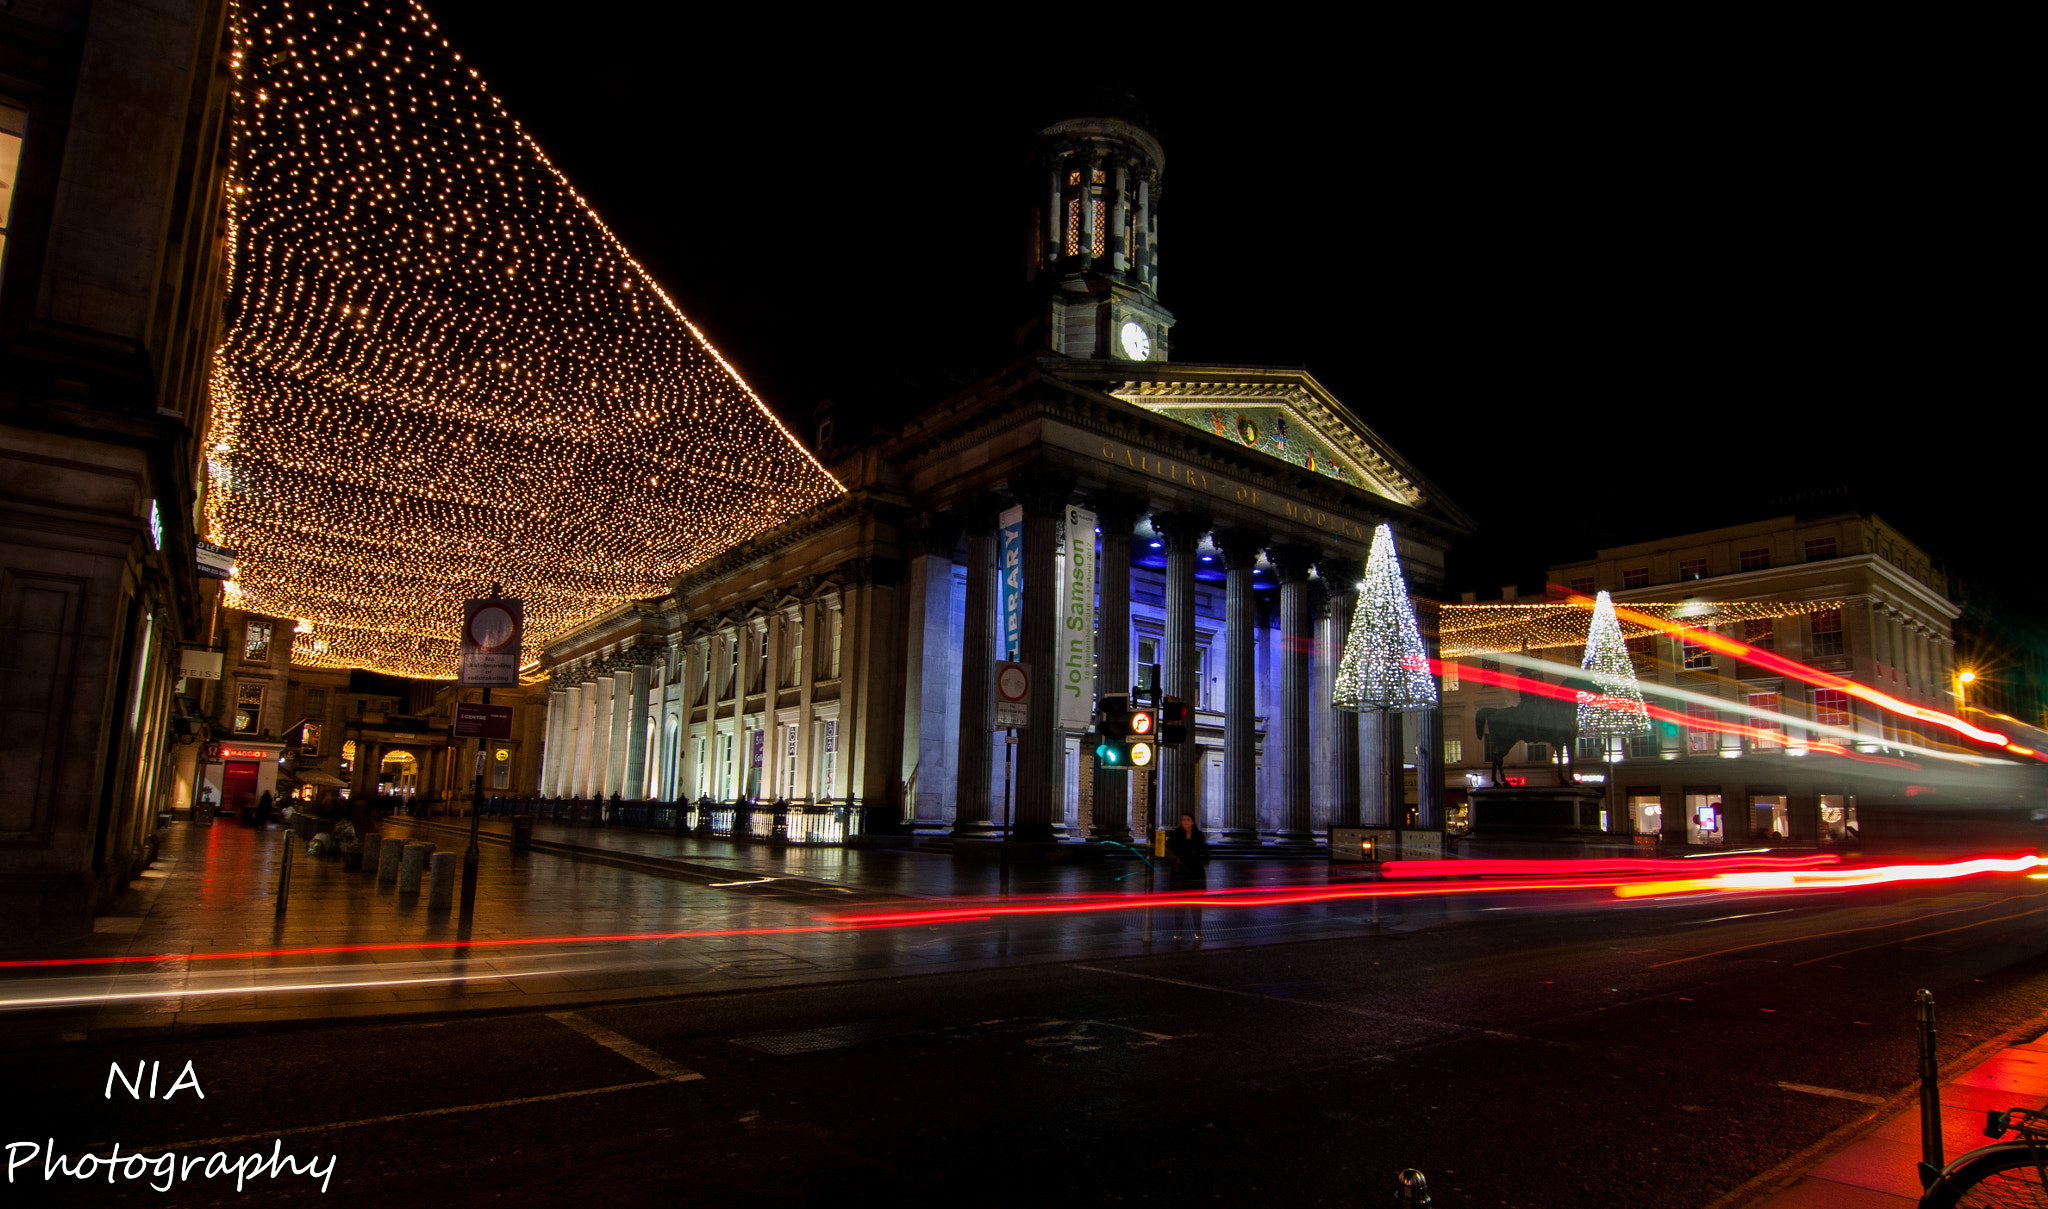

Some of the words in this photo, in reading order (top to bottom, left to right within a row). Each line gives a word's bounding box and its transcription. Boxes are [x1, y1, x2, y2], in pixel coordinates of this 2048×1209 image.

[1102, 442, 1210, 490] GALLERY
[1236, 486, 1260, 505] OF
[1285, 502, 1364, 539] MODERN
[206, 544, 220, 553] LET
[1066, 538, 1085, 632] Samson
[1005, 530, 1019, 656] LIBRARY
[180, 669, 220, 678] REISS
[1064, 639, 1084, 698] John
